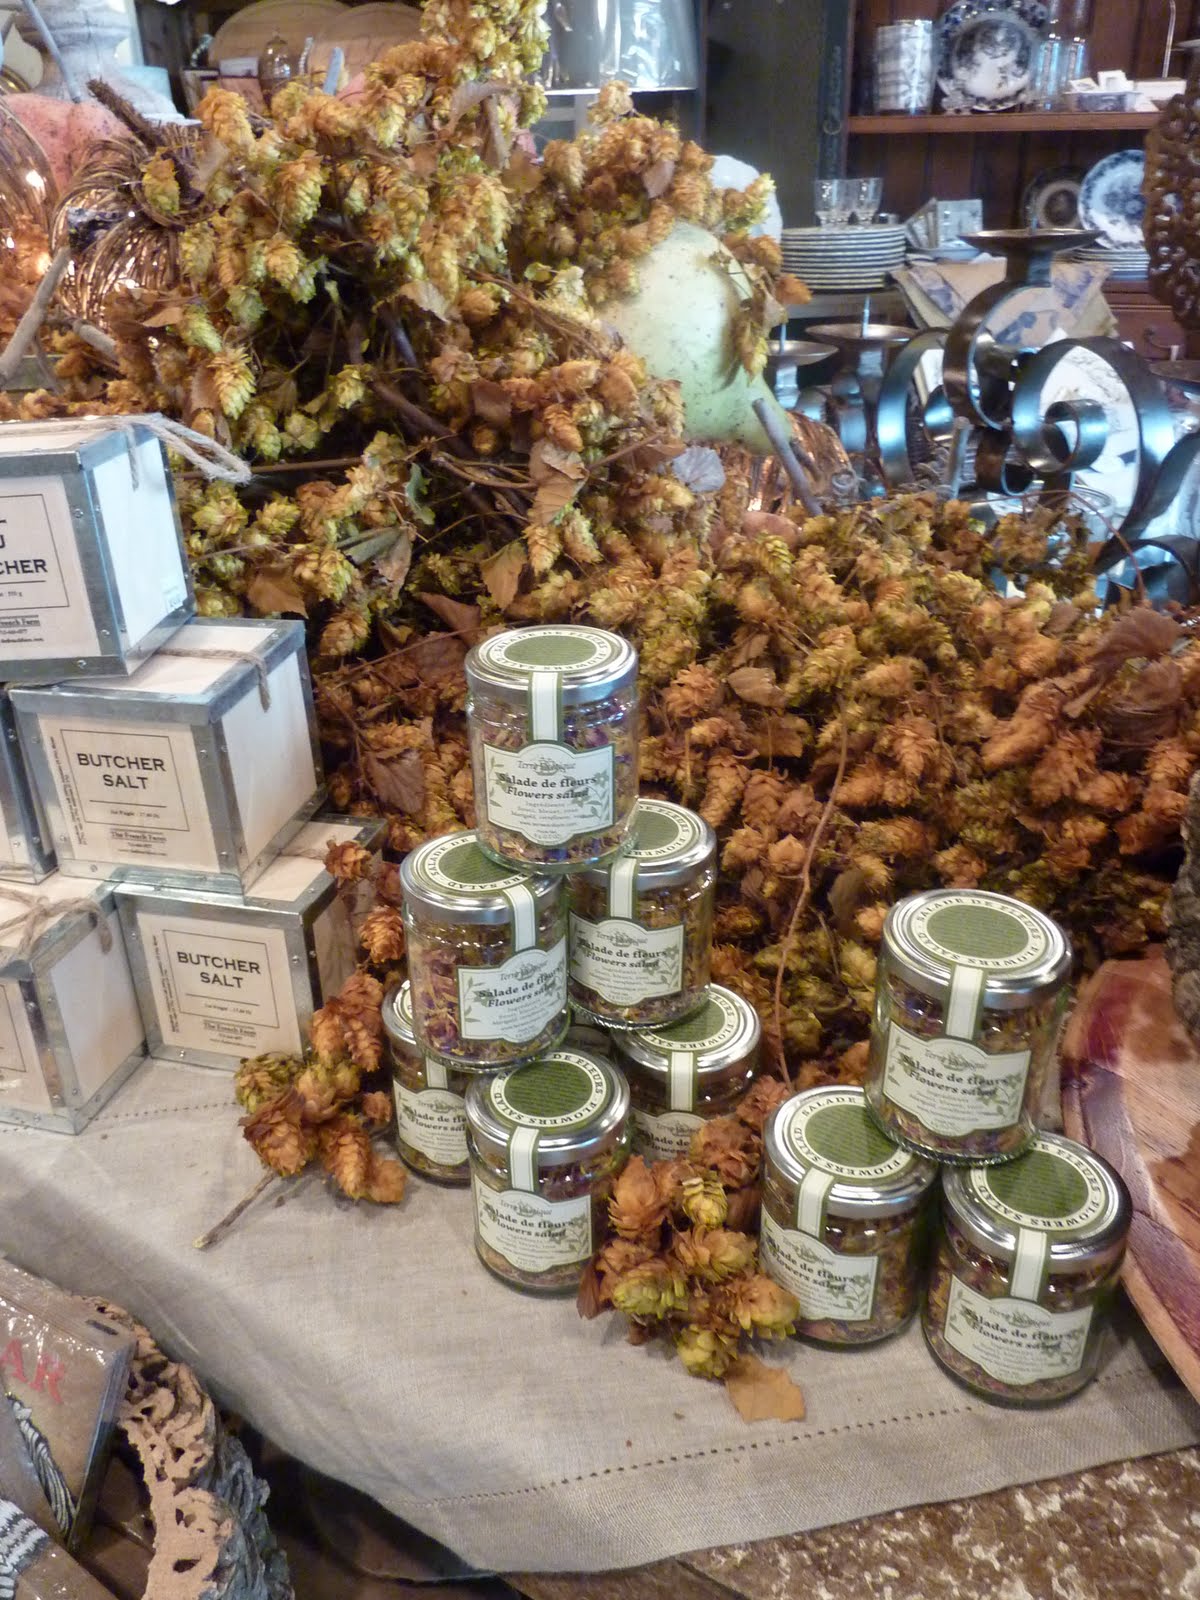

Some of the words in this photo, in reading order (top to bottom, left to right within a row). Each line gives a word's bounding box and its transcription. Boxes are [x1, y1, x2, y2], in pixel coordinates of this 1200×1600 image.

[0, 559, 48, 576] HER
[77, 753, 166, 772] BUTCHER
[102, 774, 148, 789] SALT
[499, 772, 538, 788] Salade
[541, 778, 557, 788] de
[560, 776, 597, 788] fleurs
[507, 786, 554, 800] Flowers
[451, 838, 469, 847] DE
[428, 846, 448, 876] SALADE
[448, 881, 498, 890] SALAD
[916, 898, 965, 921] SALADE
[968, 946, 1039, 967] FLOWERS
[177, 951, 261, 974] BUTCHER
[586, 951, 627, 967] Flowers
[616, 950, 630, 958] de
[633, 950, 668, 959] fleurs
[200, 972, 244, 989] SALT
[521, 982, 535, 992] de
[487, 993, 533, 1008] Flowers
[680, 1023, 734, 1049] FLOWERS
[576, 1059, 604, 1094] FLEURS
[909, 1071, 958, 1094] Flowers
[947, 1073, 963, 1084] de
[967, 1075, 1009, 1087] fleurs
[494, 1092, 524, 1120] SALAD
[529, 1103, 597, 1125] FLOWERS
[801, 1096, 857, 1117] SALADE
[437, 1115, 450, 1123] de
[450, 1124, 467, 1132] sal
[825, 1159, 901, 1176] FLOWERS
[1031, 1201, 1100, 1228] FLOWERS
[520, 1219, 535, 1228] de
[800, 1261, 814, 1274] de
[1011, 1329, 1028, 1338] de
